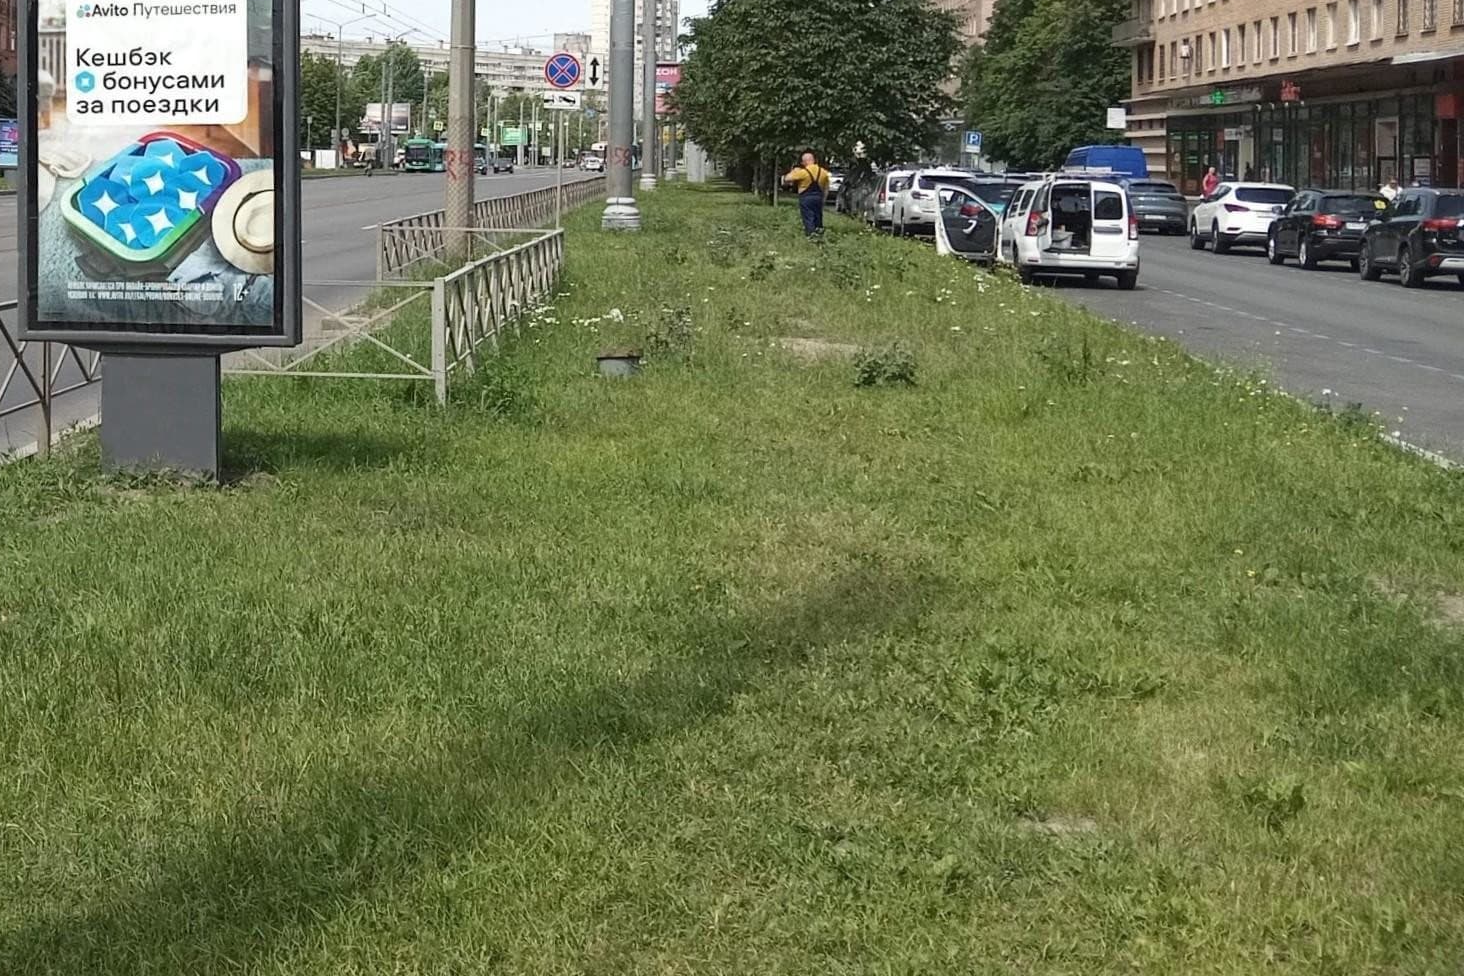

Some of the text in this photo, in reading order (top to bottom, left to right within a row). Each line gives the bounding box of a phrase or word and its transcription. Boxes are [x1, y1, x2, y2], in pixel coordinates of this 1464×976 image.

[91, 2, 237, 20] Avito Путешествия
[76, 46, 173, 67] Кешбэк
[102, 71, 226, 95] бонусами
[76, 98, 220, 117] за поездки
[233, 282, 250, 302] 12+
